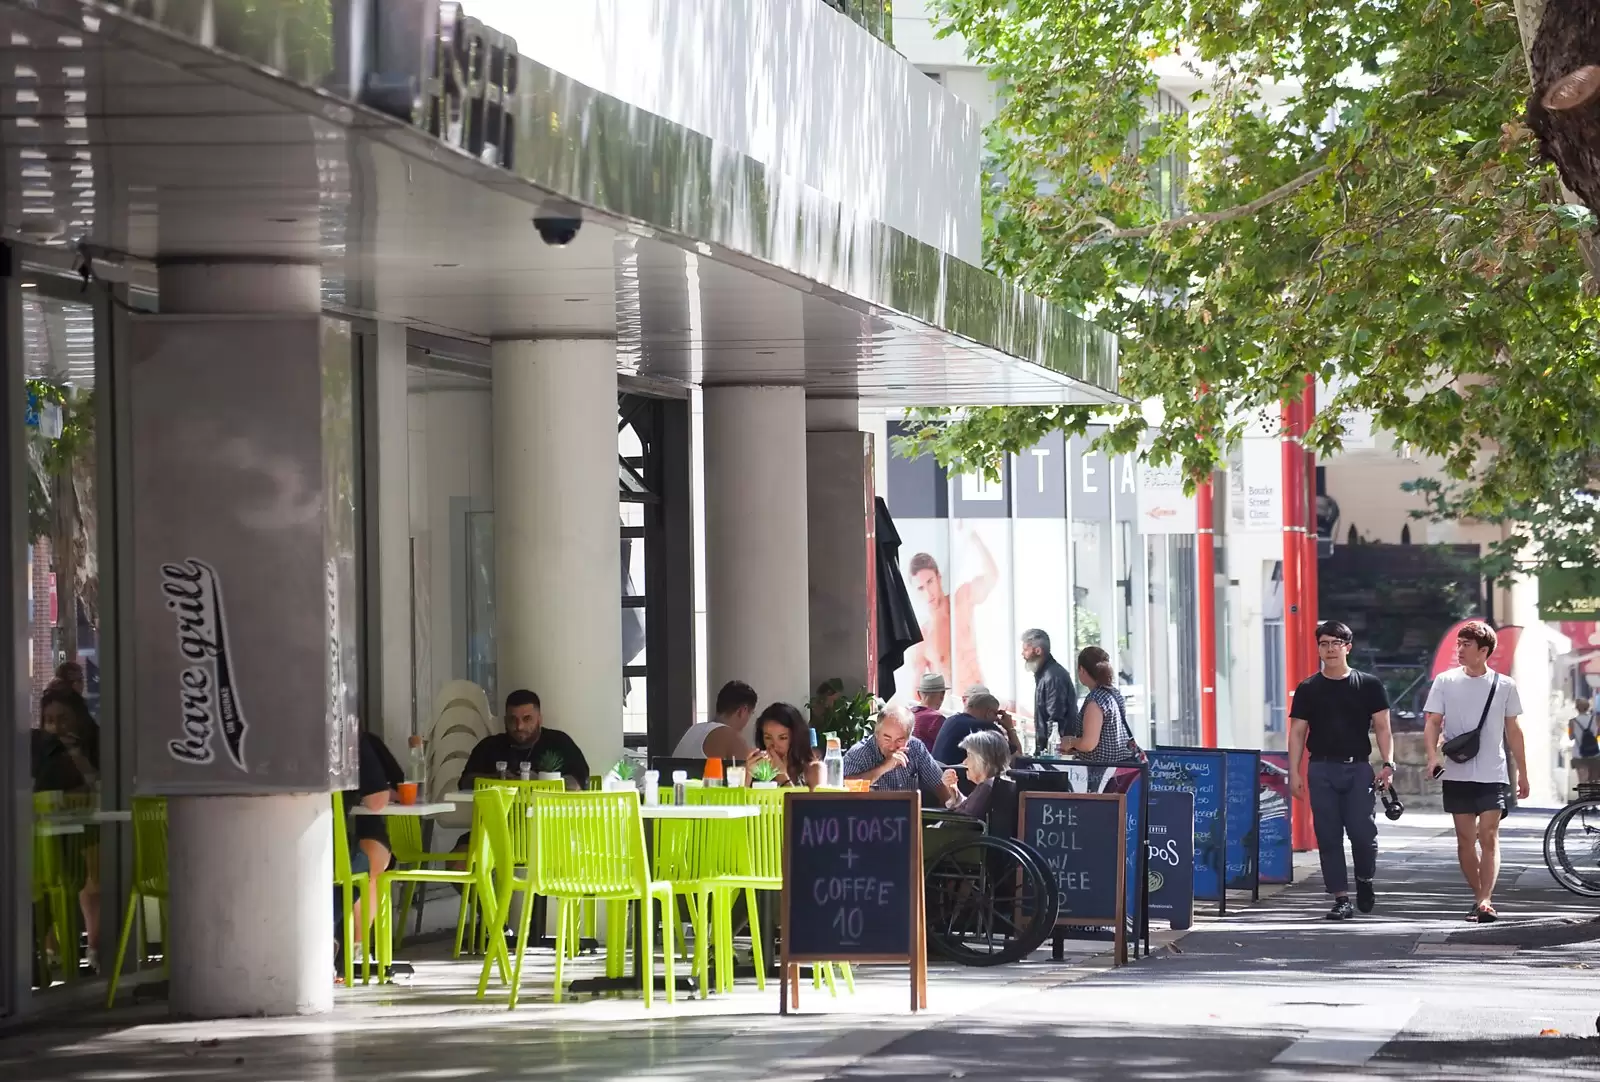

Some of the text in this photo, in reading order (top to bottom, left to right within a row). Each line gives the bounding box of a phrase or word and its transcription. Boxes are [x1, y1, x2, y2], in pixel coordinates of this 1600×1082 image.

[1248, 498, 1271, 507] Street
[162, 558, 221, 762] bare grill
[801, 816, 908, 847] AVO TOAST
[1036, 828, 1083, 850] ROLL
[814, 876, 895, 906] COFFEE
